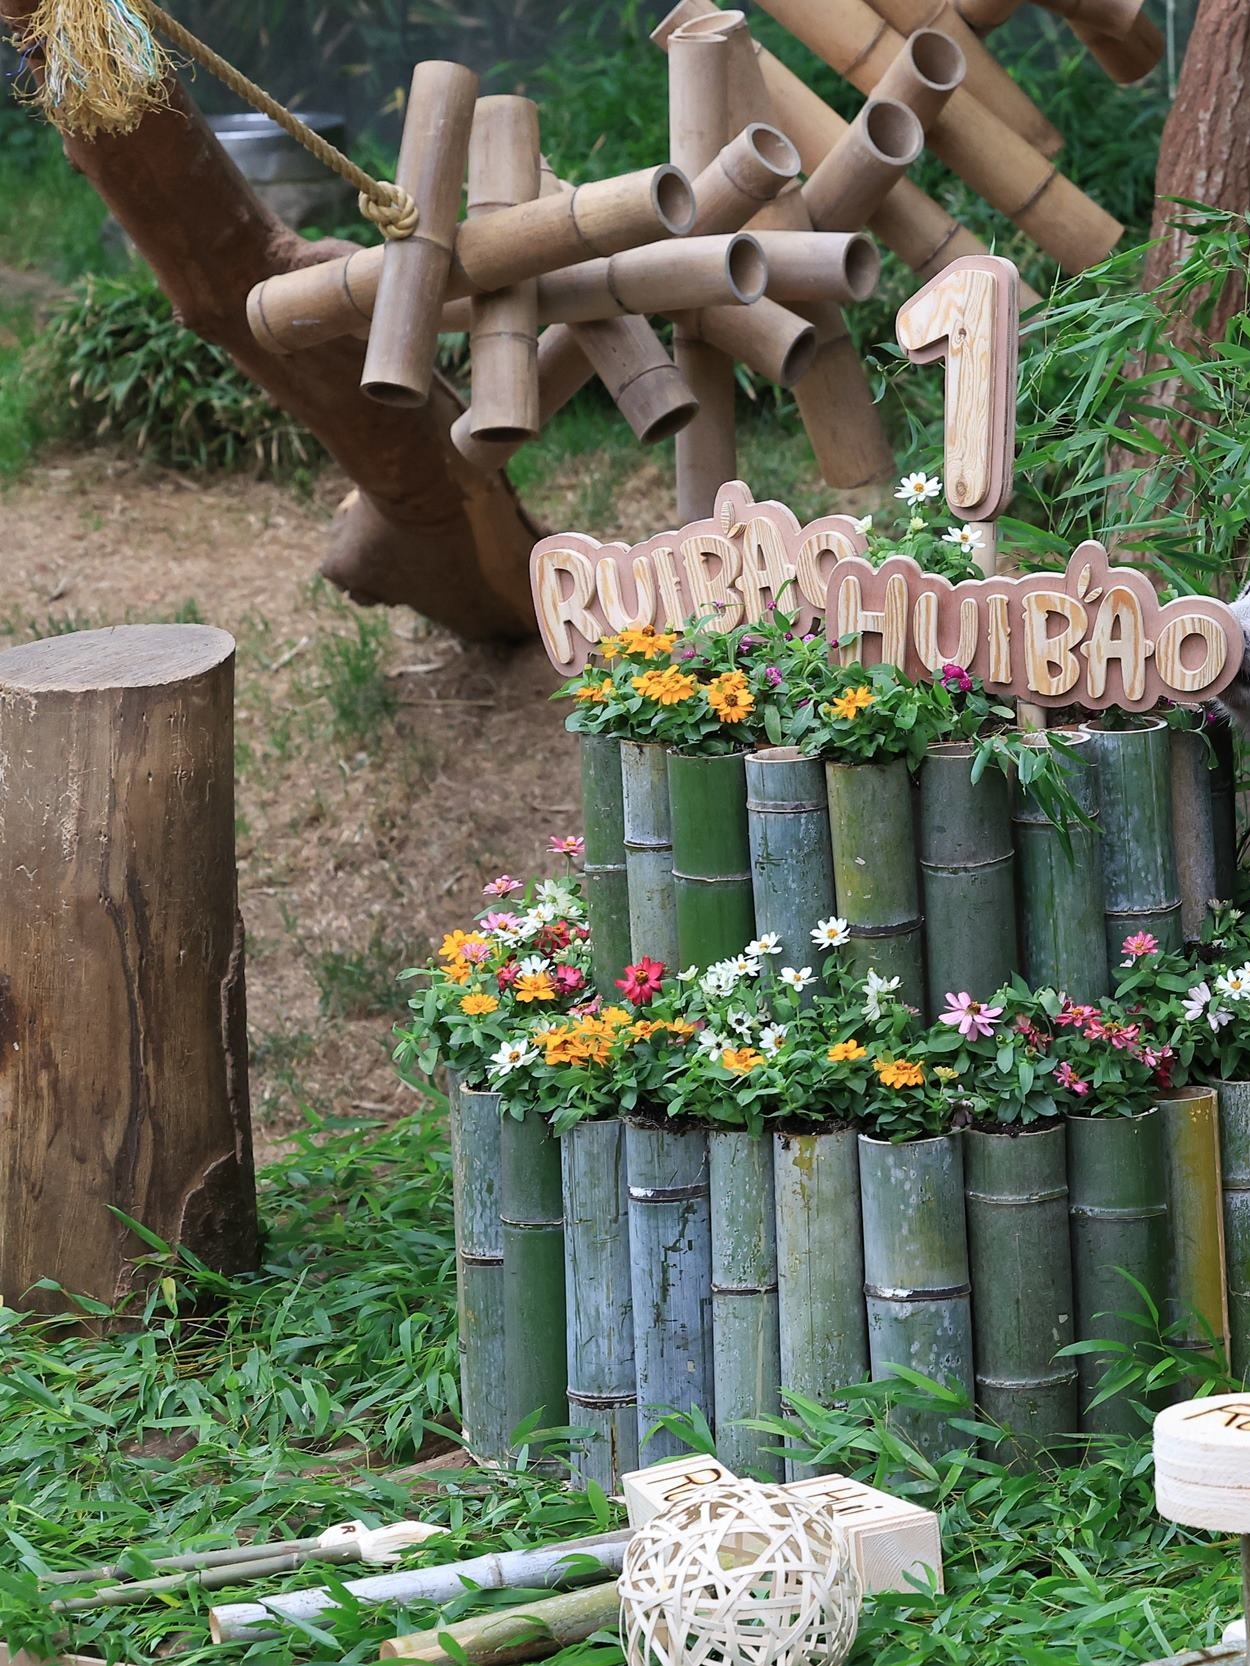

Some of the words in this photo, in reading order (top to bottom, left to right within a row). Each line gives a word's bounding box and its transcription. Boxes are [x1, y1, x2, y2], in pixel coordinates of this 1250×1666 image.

[898, 269, 998, 508] 1
[536, 515, 857, 664] RUIBAO
[838, 573, 1229, 702] HUIBAO
